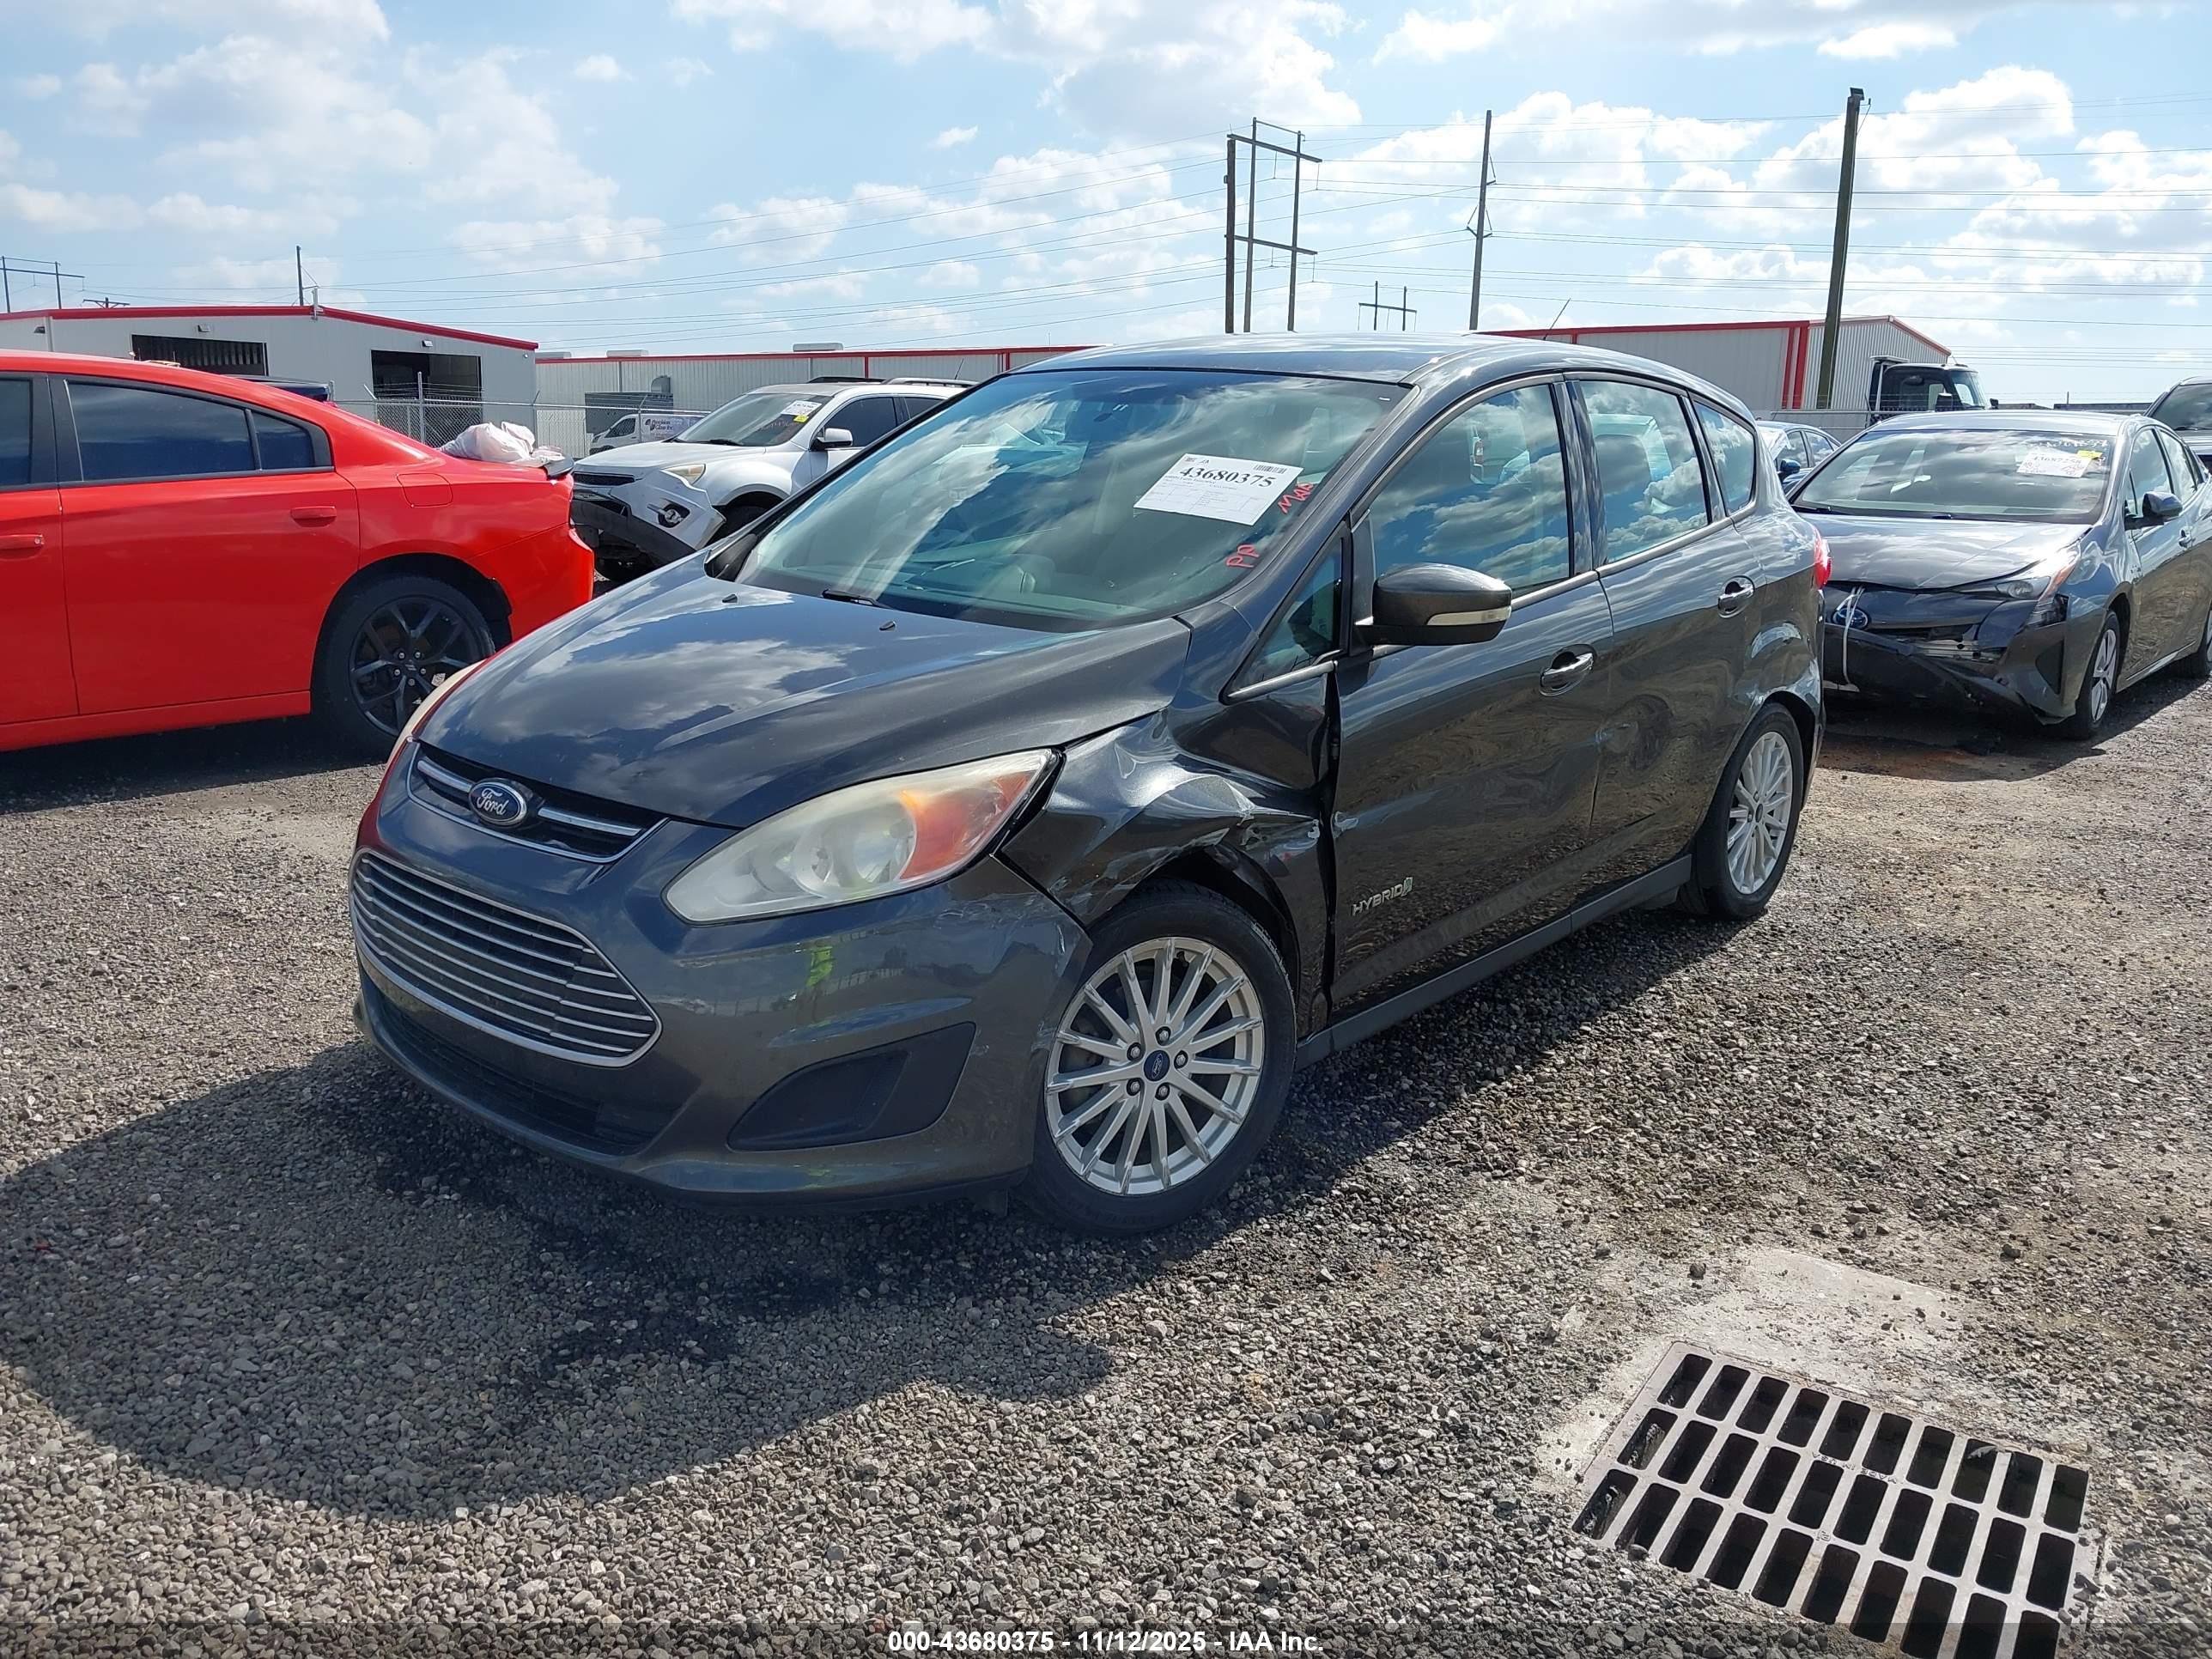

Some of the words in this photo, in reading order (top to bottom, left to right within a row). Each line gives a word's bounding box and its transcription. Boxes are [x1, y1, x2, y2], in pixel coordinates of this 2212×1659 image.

[1179, 466, 1277, 488] 43680375
[476, 787, 510, 816] Ford
[1351, 884, 1403, 916] HYBRID
